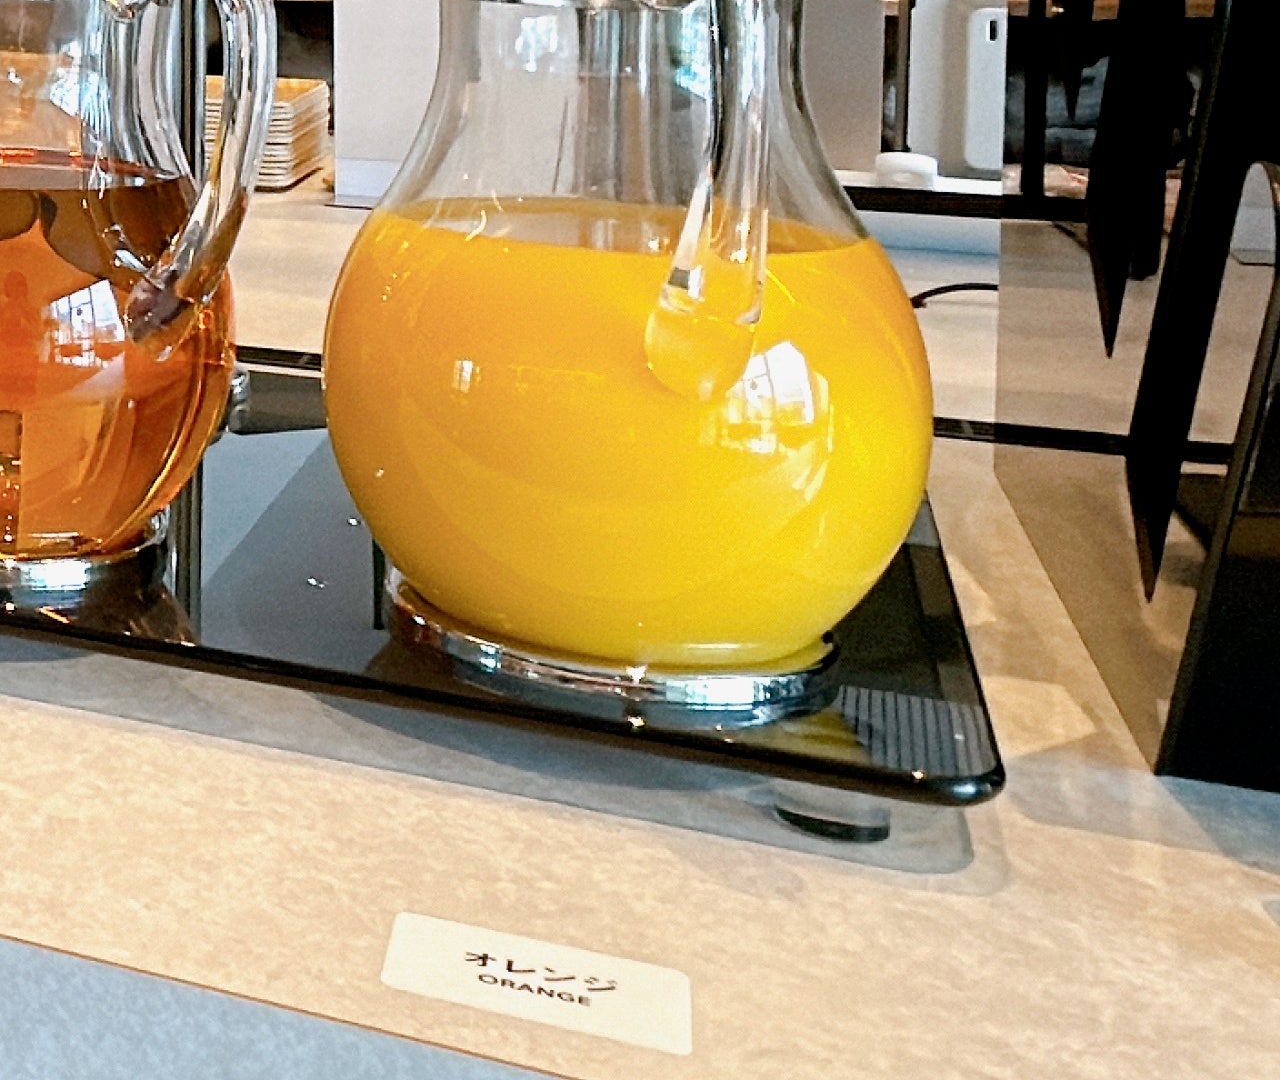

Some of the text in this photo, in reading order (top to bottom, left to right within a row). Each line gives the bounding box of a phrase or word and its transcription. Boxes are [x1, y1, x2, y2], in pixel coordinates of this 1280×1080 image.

[464, 951, 618, 992] オレンジ
[478, 973, 592, 1007] ORANGE
